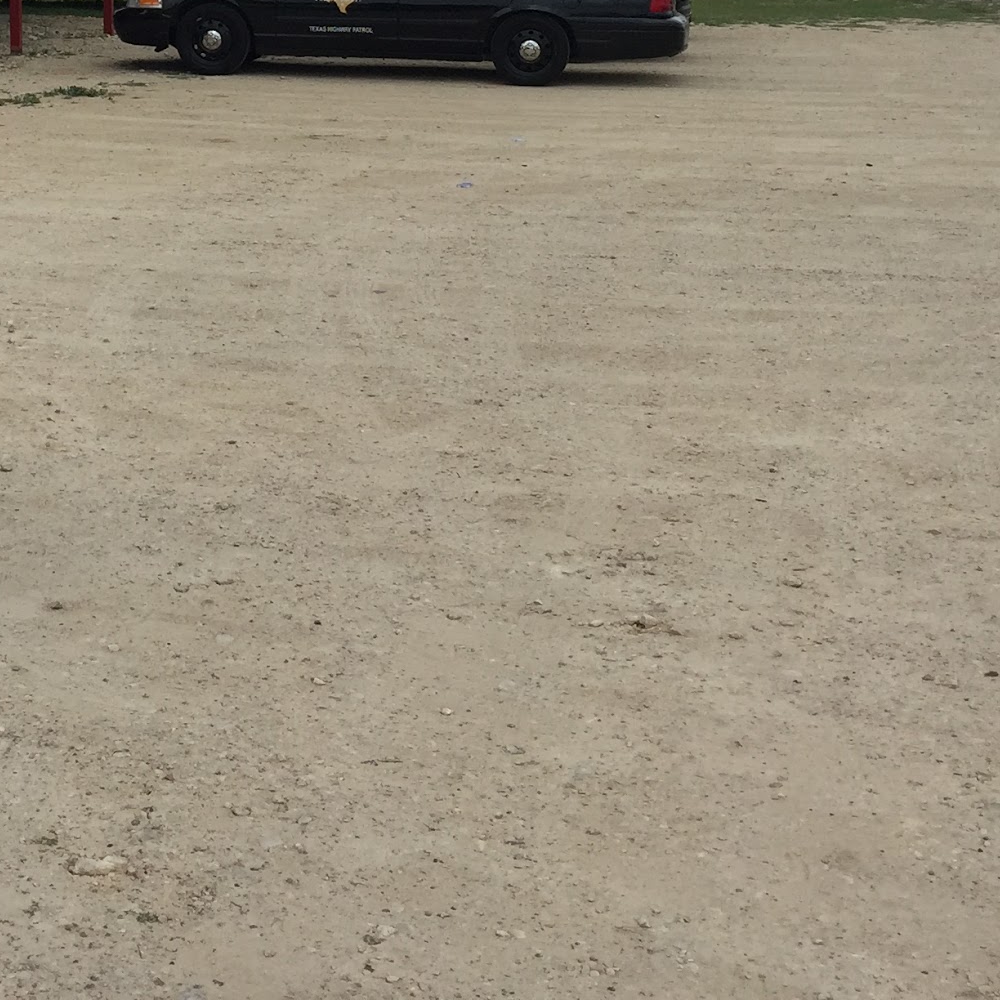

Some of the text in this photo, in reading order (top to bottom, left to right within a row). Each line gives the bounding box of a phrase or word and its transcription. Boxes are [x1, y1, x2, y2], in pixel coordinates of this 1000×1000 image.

[309, 25, 373, 34] TEXAS HIGHWAY PATROL
